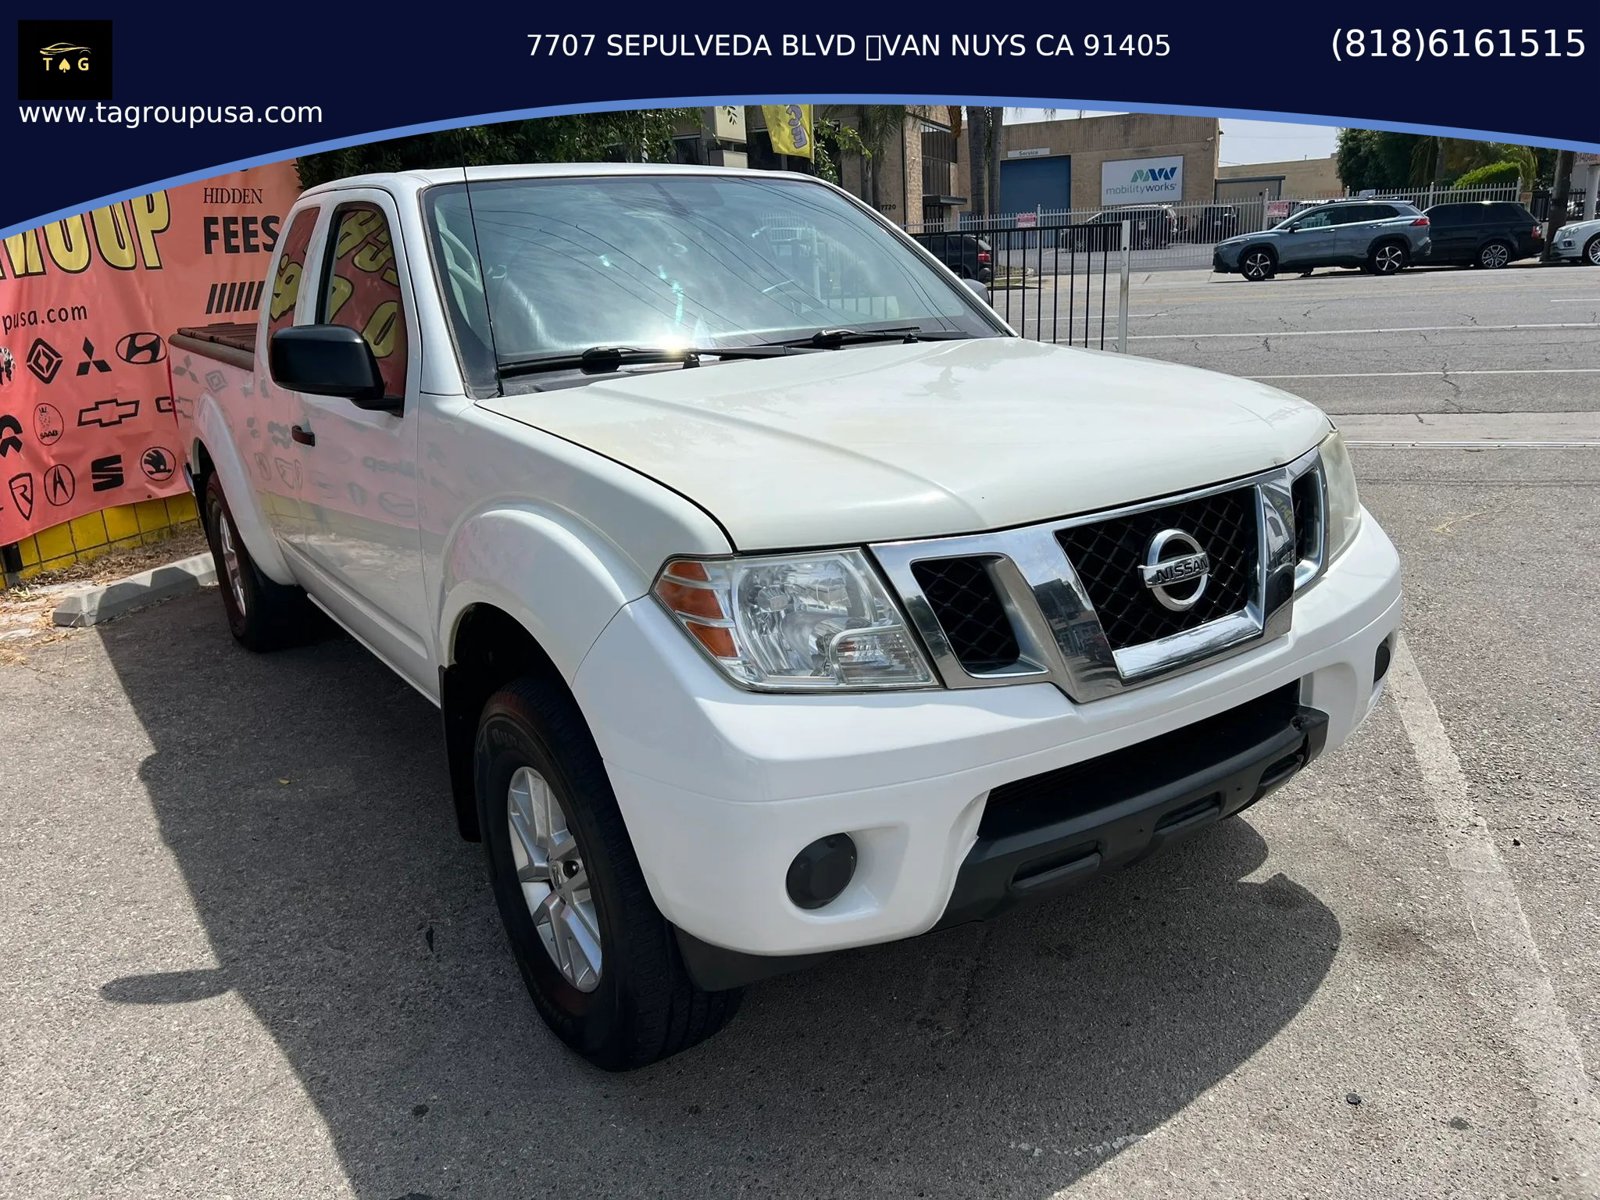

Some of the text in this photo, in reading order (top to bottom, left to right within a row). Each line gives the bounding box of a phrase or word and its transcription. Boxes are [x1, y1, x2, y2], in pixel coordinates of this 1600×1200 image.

[1018, 150, 1039, 158] Service
[203, 187, 263, 205] HIDDEN
[203, 215, 281, 255] FEES
[1155, 556, 1209, 582] NISSAN
